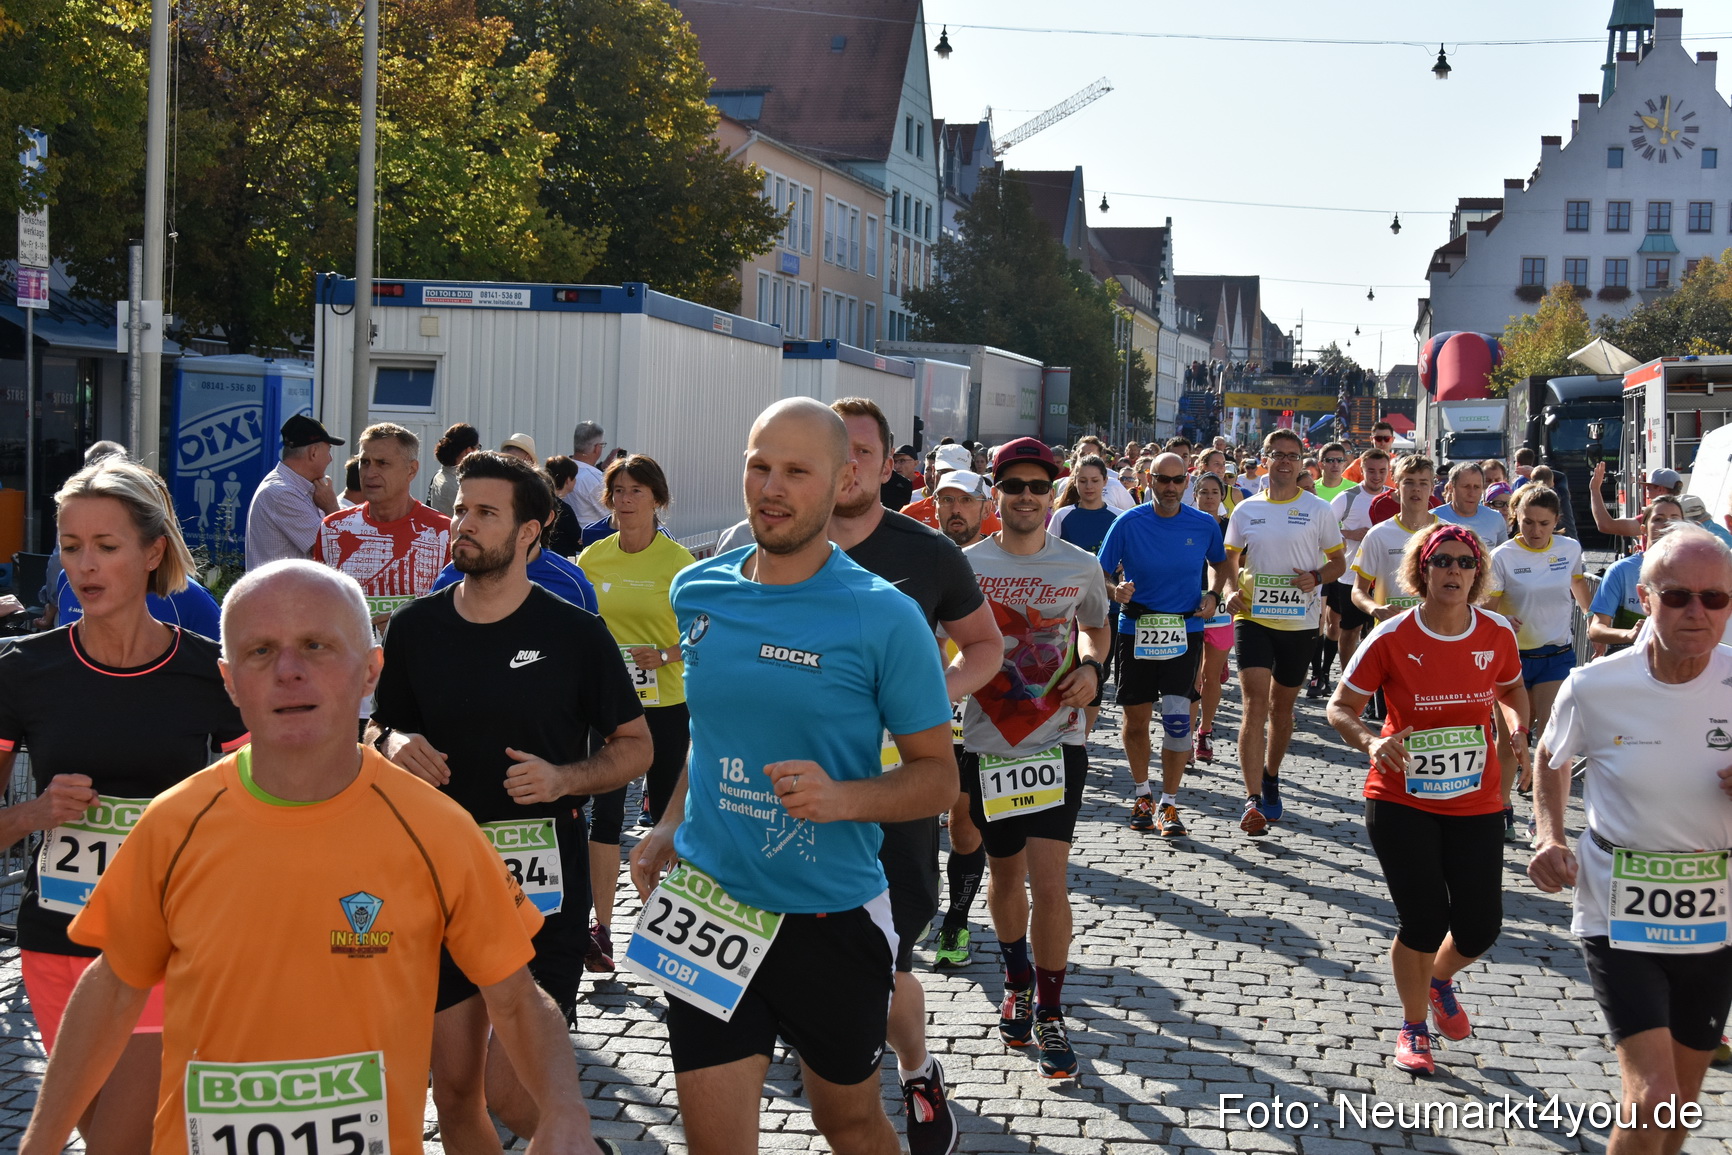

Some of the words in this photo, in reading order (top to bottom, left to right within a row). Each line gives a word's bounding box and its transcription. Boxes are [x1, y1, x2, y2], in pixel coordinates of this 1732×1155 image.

[23, 227, 45, 239] werktags
[201, 381, 224, 390] 08141
[231, 383, 244, 392] 536
[246, 384, 256, 392] 80
[1261, 398, 1299, 408] START
[1037, 584, 1079, 600] TEAM
[1258, 590, 1301, 604] 2544
[1002, 597, 1028, 606] ROTH
[1033, 597, 1057, 605] 2016
[1260, 606, 1298, 615] ANDREAS
[1140, 616, 1181, 627] BOCK
[1141, 630, 1180, 645] 2224
[516, 650, 540, 661] RUN
[760, 643, 823, 668] BOCK
[1144, 647, 1178, 655] THOMAS
[1415, 693, 1463, 701] ENGELHARDT
[1409, 730, 1479, 750] BOCK
[719, 757, 750, 783] 18.
[1414, 750, 1476, 775] 2517
[990, 764, 1056, 793] 1100
[1423, 778, 1470, 791] MARION
[1011, 795, 1034, 807] TIM
[719, 798, 777, 824] Stadtlauf
[765, 850, 775, 859] 17.
[772, 828, 798, 852] September
[1623, 854, 1720, 879] BOCK
[664, 863, 764, 933] BOCK
[953, 873, 979, 911] Kalenji
[1624, 886, 1716, 918] 2082
[331, 931, 391, 946] INFERNO
[646, 896, 749, 971] 2350
[752, 946, 760, 954] C
[1645, 926, 1696, 941] WILLI
[656, 952, 700, 986] TOBI
[201, 1062, 368, 1107] BOCK
[212, 1113, 365, 1155] 1015
[369, 1113, 378, 1123] D
